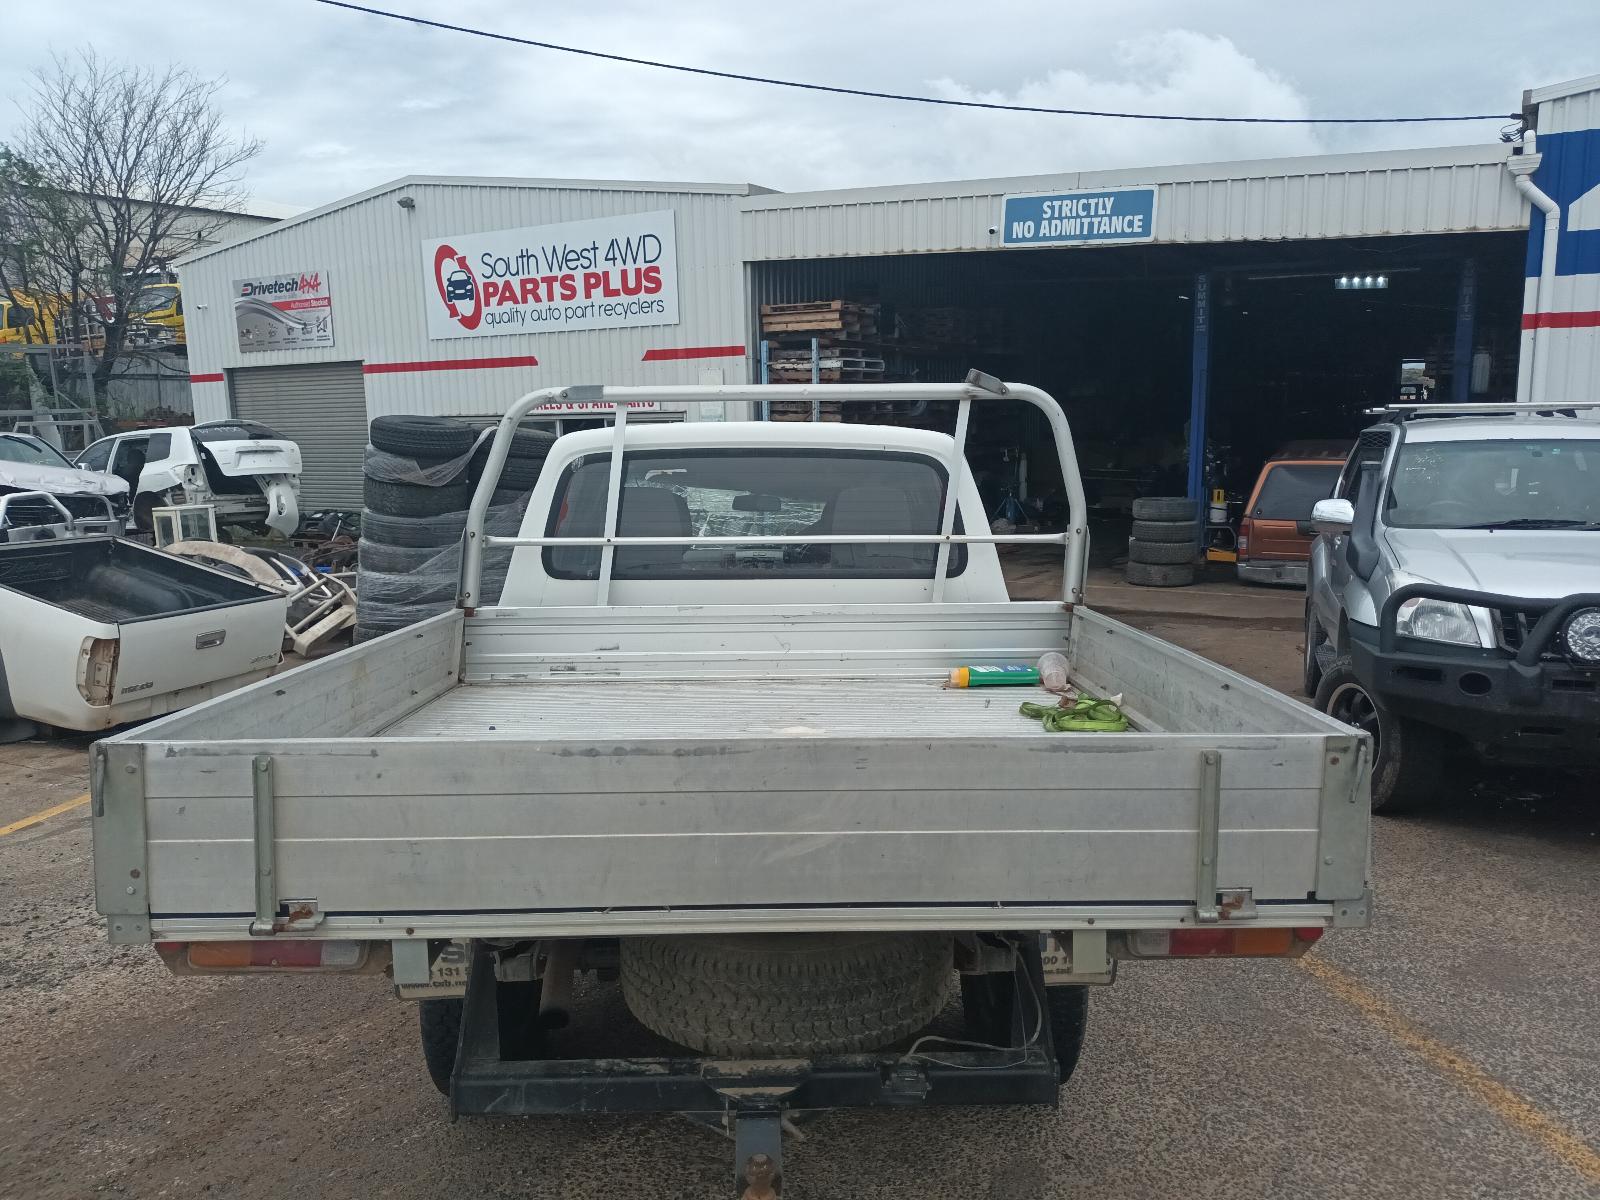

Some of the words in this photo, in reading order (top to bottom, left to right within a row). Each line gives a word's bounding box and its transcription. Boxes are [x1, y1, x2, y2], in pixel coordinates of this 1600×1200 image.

[1042, 197, 1115, 219] STRICTLY
[1012, 221, 1035, 239] NO
[1039, 214, 1144, 237] ADMITTANCE
[481, 248, 540, 280] South
[541, 240, 600, 273] West
[604, 233, 662, 267] 4WD
[241, 277, 299, 297] Drivetech
[482, 273, 578, 308] PARTS
[583, 265, 663, 300] PLUS
[485, 306, 527, 329] quality
[530, 304, 562, 323] auto
[564, 301, 596, 324] part
[598, 298, 665, 320] recyclers
